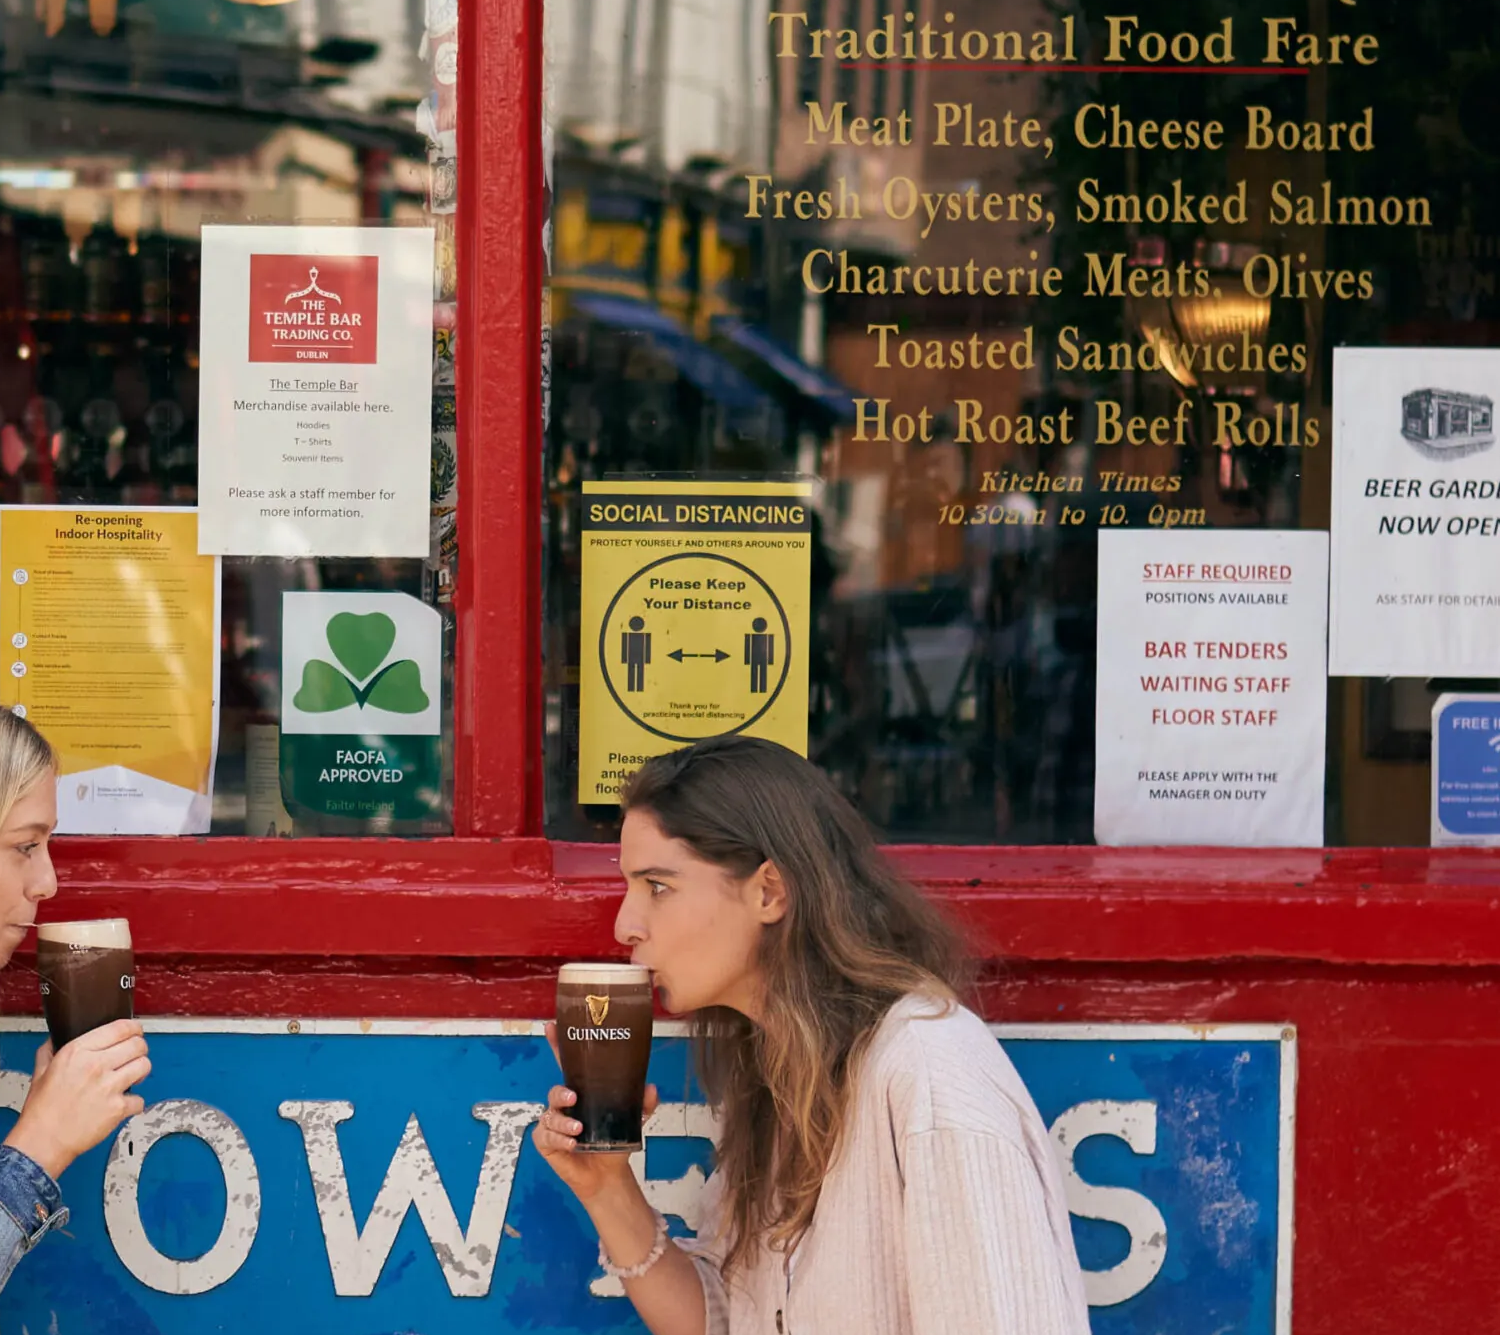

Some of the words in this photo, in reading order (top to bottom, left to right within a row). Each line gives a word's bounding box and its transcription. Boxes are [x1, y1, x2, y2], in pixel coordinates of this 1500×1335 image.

[769, 11, 1077, 61] Traditional
[1105, 16, 1235, 63] Food
[1262, 16, 1379, 66] Fare
[805, 101, 912, 147] Meat
[933, 102, 1055, 158] Plate,
[1074, 103, 1224, 150] Cheese
[1245, 106, 1374, 151] Board
[744, 175, 862, 219] Fresh
[882, 176, 1056, 239] Oysters,
[1077, 178, 1248, 225] Smoked
[1269, 181, 1432, 226] Salmon
[801, 249, 1063, 297] Charcuterie
[1243, 252, 1375, 300] Olives
[302, 300, 325, 311] THE
[264, 312, 325, 325] TEMPLE
[330, 313, 361, 326] BAR
[272, 329, 329, 340] TRADING
[296, 351, 328, 359] DUBLIN
[868, 324, 1034, 369] Toasted
[1057, 325, 1308, 373] Sandwiches
[270, 379, 290, 389] The
[294, 379, 336, 391] Temple
[233, 400, 307, 411] Merchandise
[311, 400, 360, 412] available
[852, 398, 934, 443] Hot
[955, 399, 1073, 445] Roast
[1096, 399, 1193, 445] Beef
[1214, 402, 1320, 447] Rolls
[980, 471, 1084, 493] Kitchen
[1100, 471, 1181, 493] Times
[1364, 479, 1422, 498] BEER
[229, 488, 265, 499] Please
[268, 488, 286, 499] ask
[299, 488, 325, 499] staff
[328, 489, 376, 500] member
[260, 509, 290, 517] more
[293, 507, 364, 518] information.
[590, 504, 668, 523] SOCIAL
[676, 505, 805, 524] DISTANCING
[1060, 504, 1085, 526] to
[75, 515, 143, 528] Re-opening
[1379, 516, 1441, 535] NOW
[55, 529, 94, 539] Indoor
[97, 529, 162, 542] Hospitality
[590, 539, 632, 547] PROTECT
[706, 540, 743, 548] OTHERS
[1143, 564, 1195, 580] STAFF
[1202, 564, 1291, 581] REQUIRED
[650, 578, 701, 590] Please
[706, 579, 746, 592] Keep
[643, 598, 678, 610] Your
[683, 598, 752, 610] Distance
[1146, 592, 1215, 604] POSITIONS
[1219, 593, 1288, 604] AVAILABLE
[1145, 641, 1186, 659] BAR
[1193, 642, 1288, 660] TENDERS
[1140, 676, 1227, 693] WAITING
[1234, 677, 1291, 693] STAFF
[1152, 709, 1215, 725] FLOOR
[1221, 709, 1278, 726] STAFF
[1453, 717, 1490, 730] FREE
[336, 750, 386, 765] FAOFA
[319, 769, 403, 783] APPROVED
[1138, 771, 1179, 782] PLEASE
[1183, 771, 1218, 782] APPLY
[1222, 772, 1253, 782] WITH
[1257, 772, 1278, 783] THE
[1149, 789, 1210, 800] MANAGER
[1235, 789, 1267, 800] DUTY
[567, 1027, 631, 1041] GUINNESS
